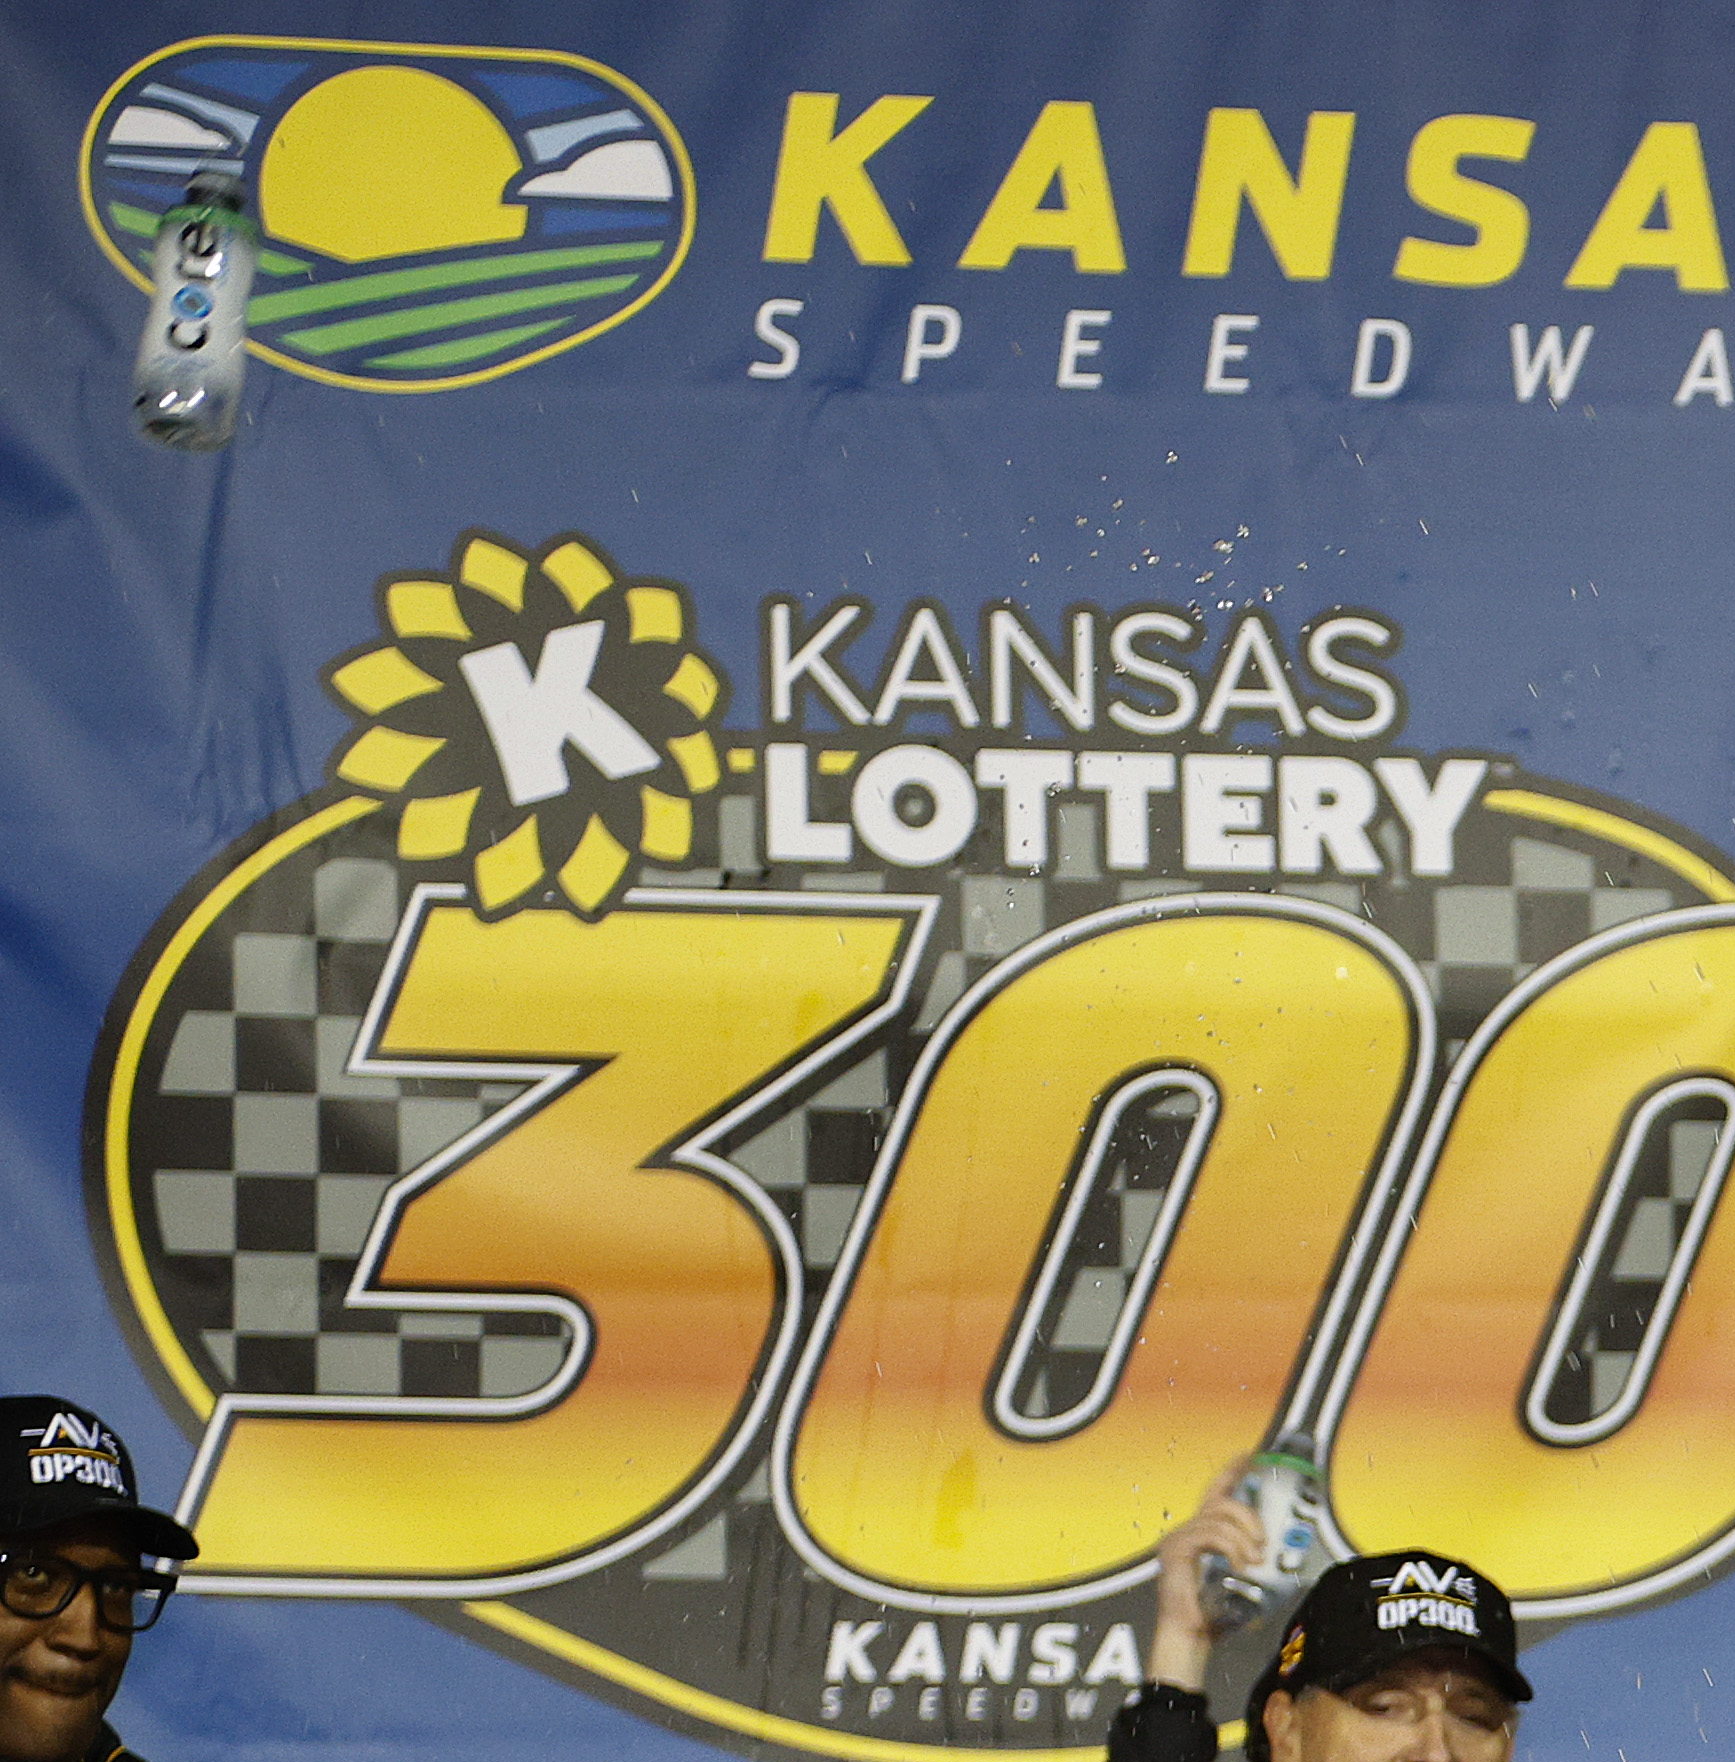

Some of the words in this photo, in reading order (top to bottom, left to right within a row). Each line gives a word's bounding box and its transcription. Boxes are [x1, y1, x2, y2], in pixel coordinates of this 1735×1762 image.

[458, 620, 661, 805] K
[771, 604, 1399, 738] KANSAS
[765, 743, 1490, 876] LOTTERY
[820, 1686, 1142, 1722] SPEEDW
[824, 1619, 1143, 1686] KANSA
